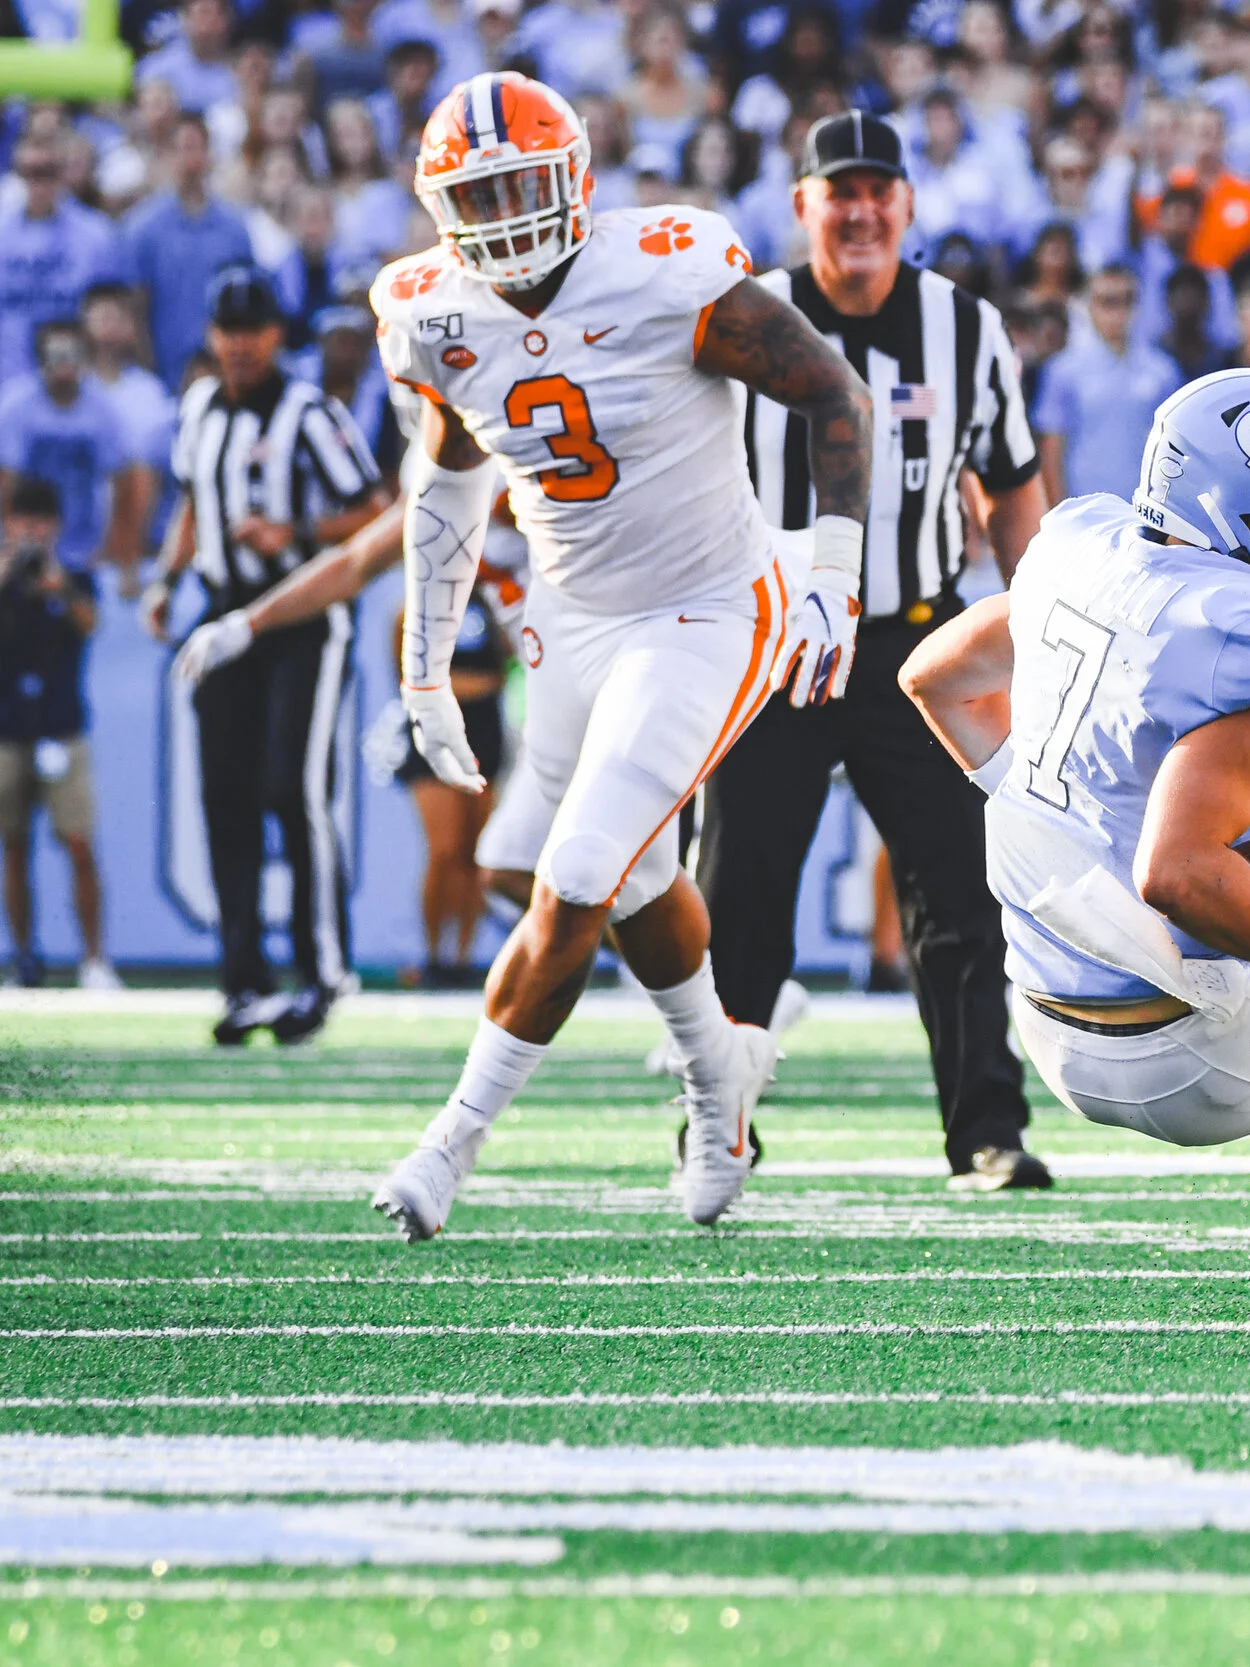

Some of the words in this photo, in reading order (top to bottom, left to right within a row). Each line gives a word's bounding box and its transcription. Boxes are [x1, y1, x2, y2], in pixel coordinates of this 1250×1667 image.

[503, 373, 620, 502] 3
[905, 459, 927, 492] U
[1026, 597, 1117, 813] 7
